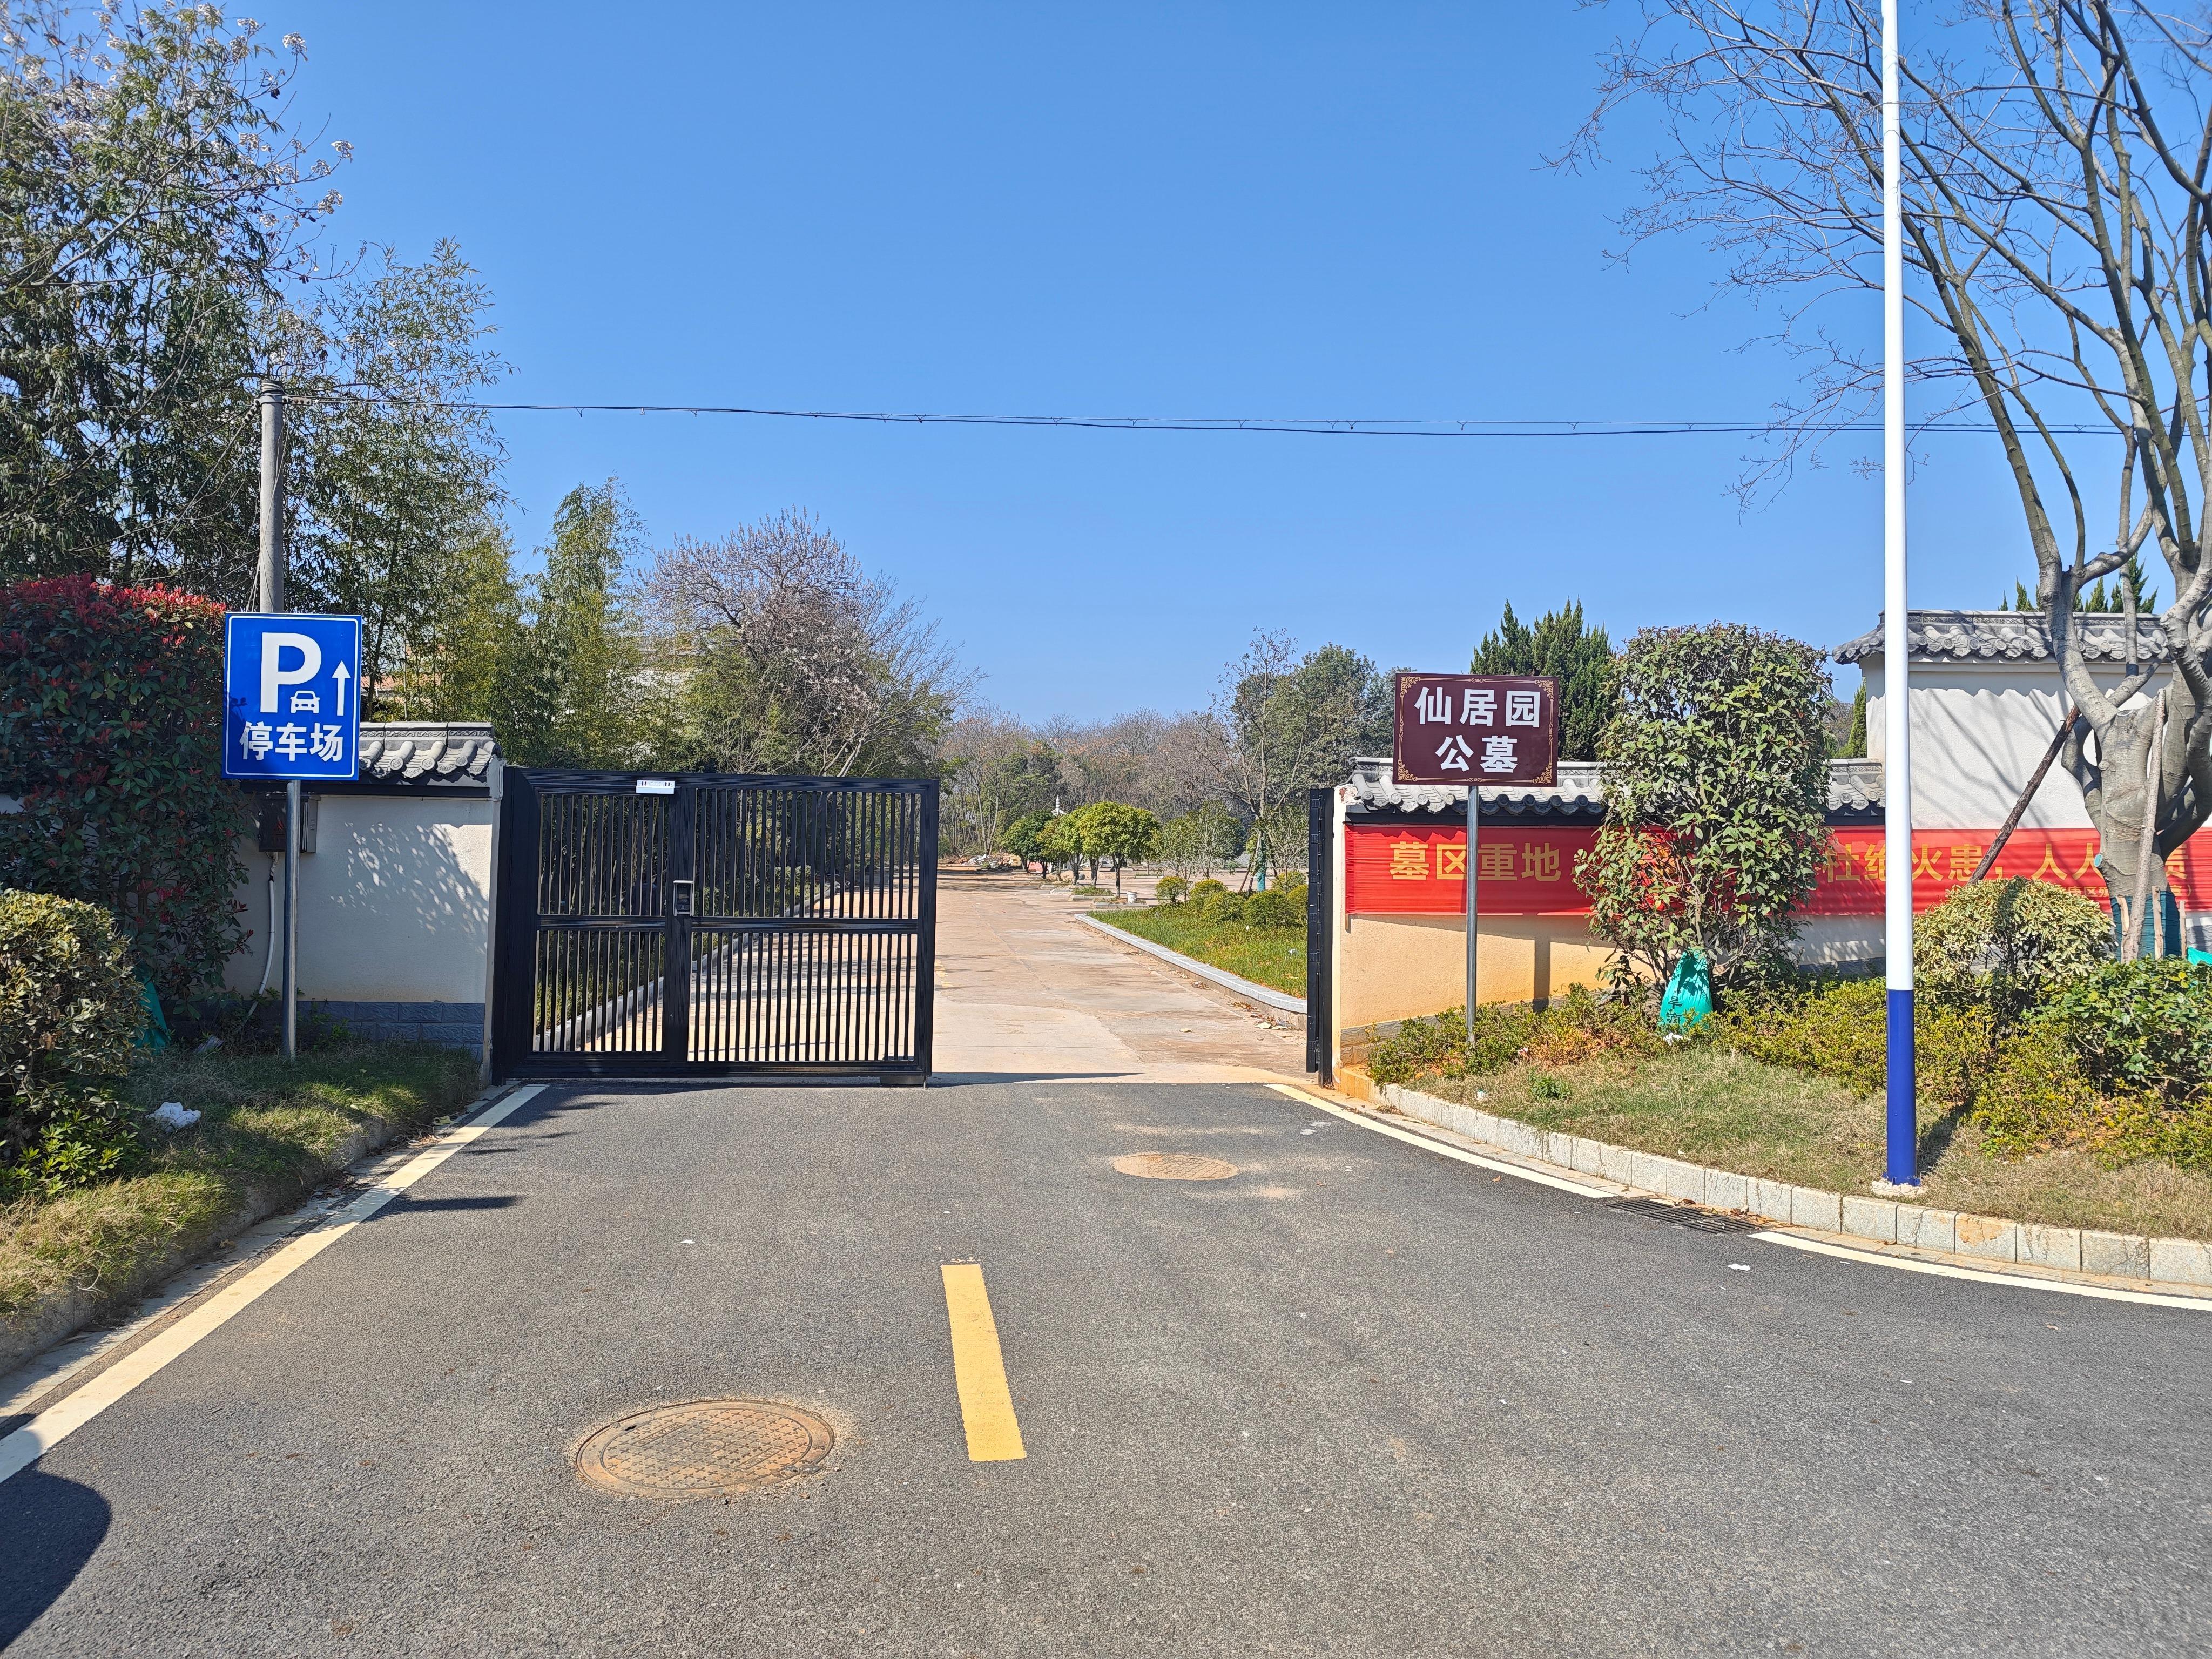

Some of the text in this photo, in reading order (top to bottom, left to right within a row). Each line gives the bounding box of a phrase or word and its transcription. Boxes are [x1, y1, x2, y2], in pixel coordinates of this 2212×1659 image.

[260, 632, 322, 713] P
[1414, 686, 1540, 728] 仙居园
[239, 721, 344, 762] 停车场
[1434, 734, 1518, 773] 公墓
[1389, 841, 1562, 882] 墓区重地
